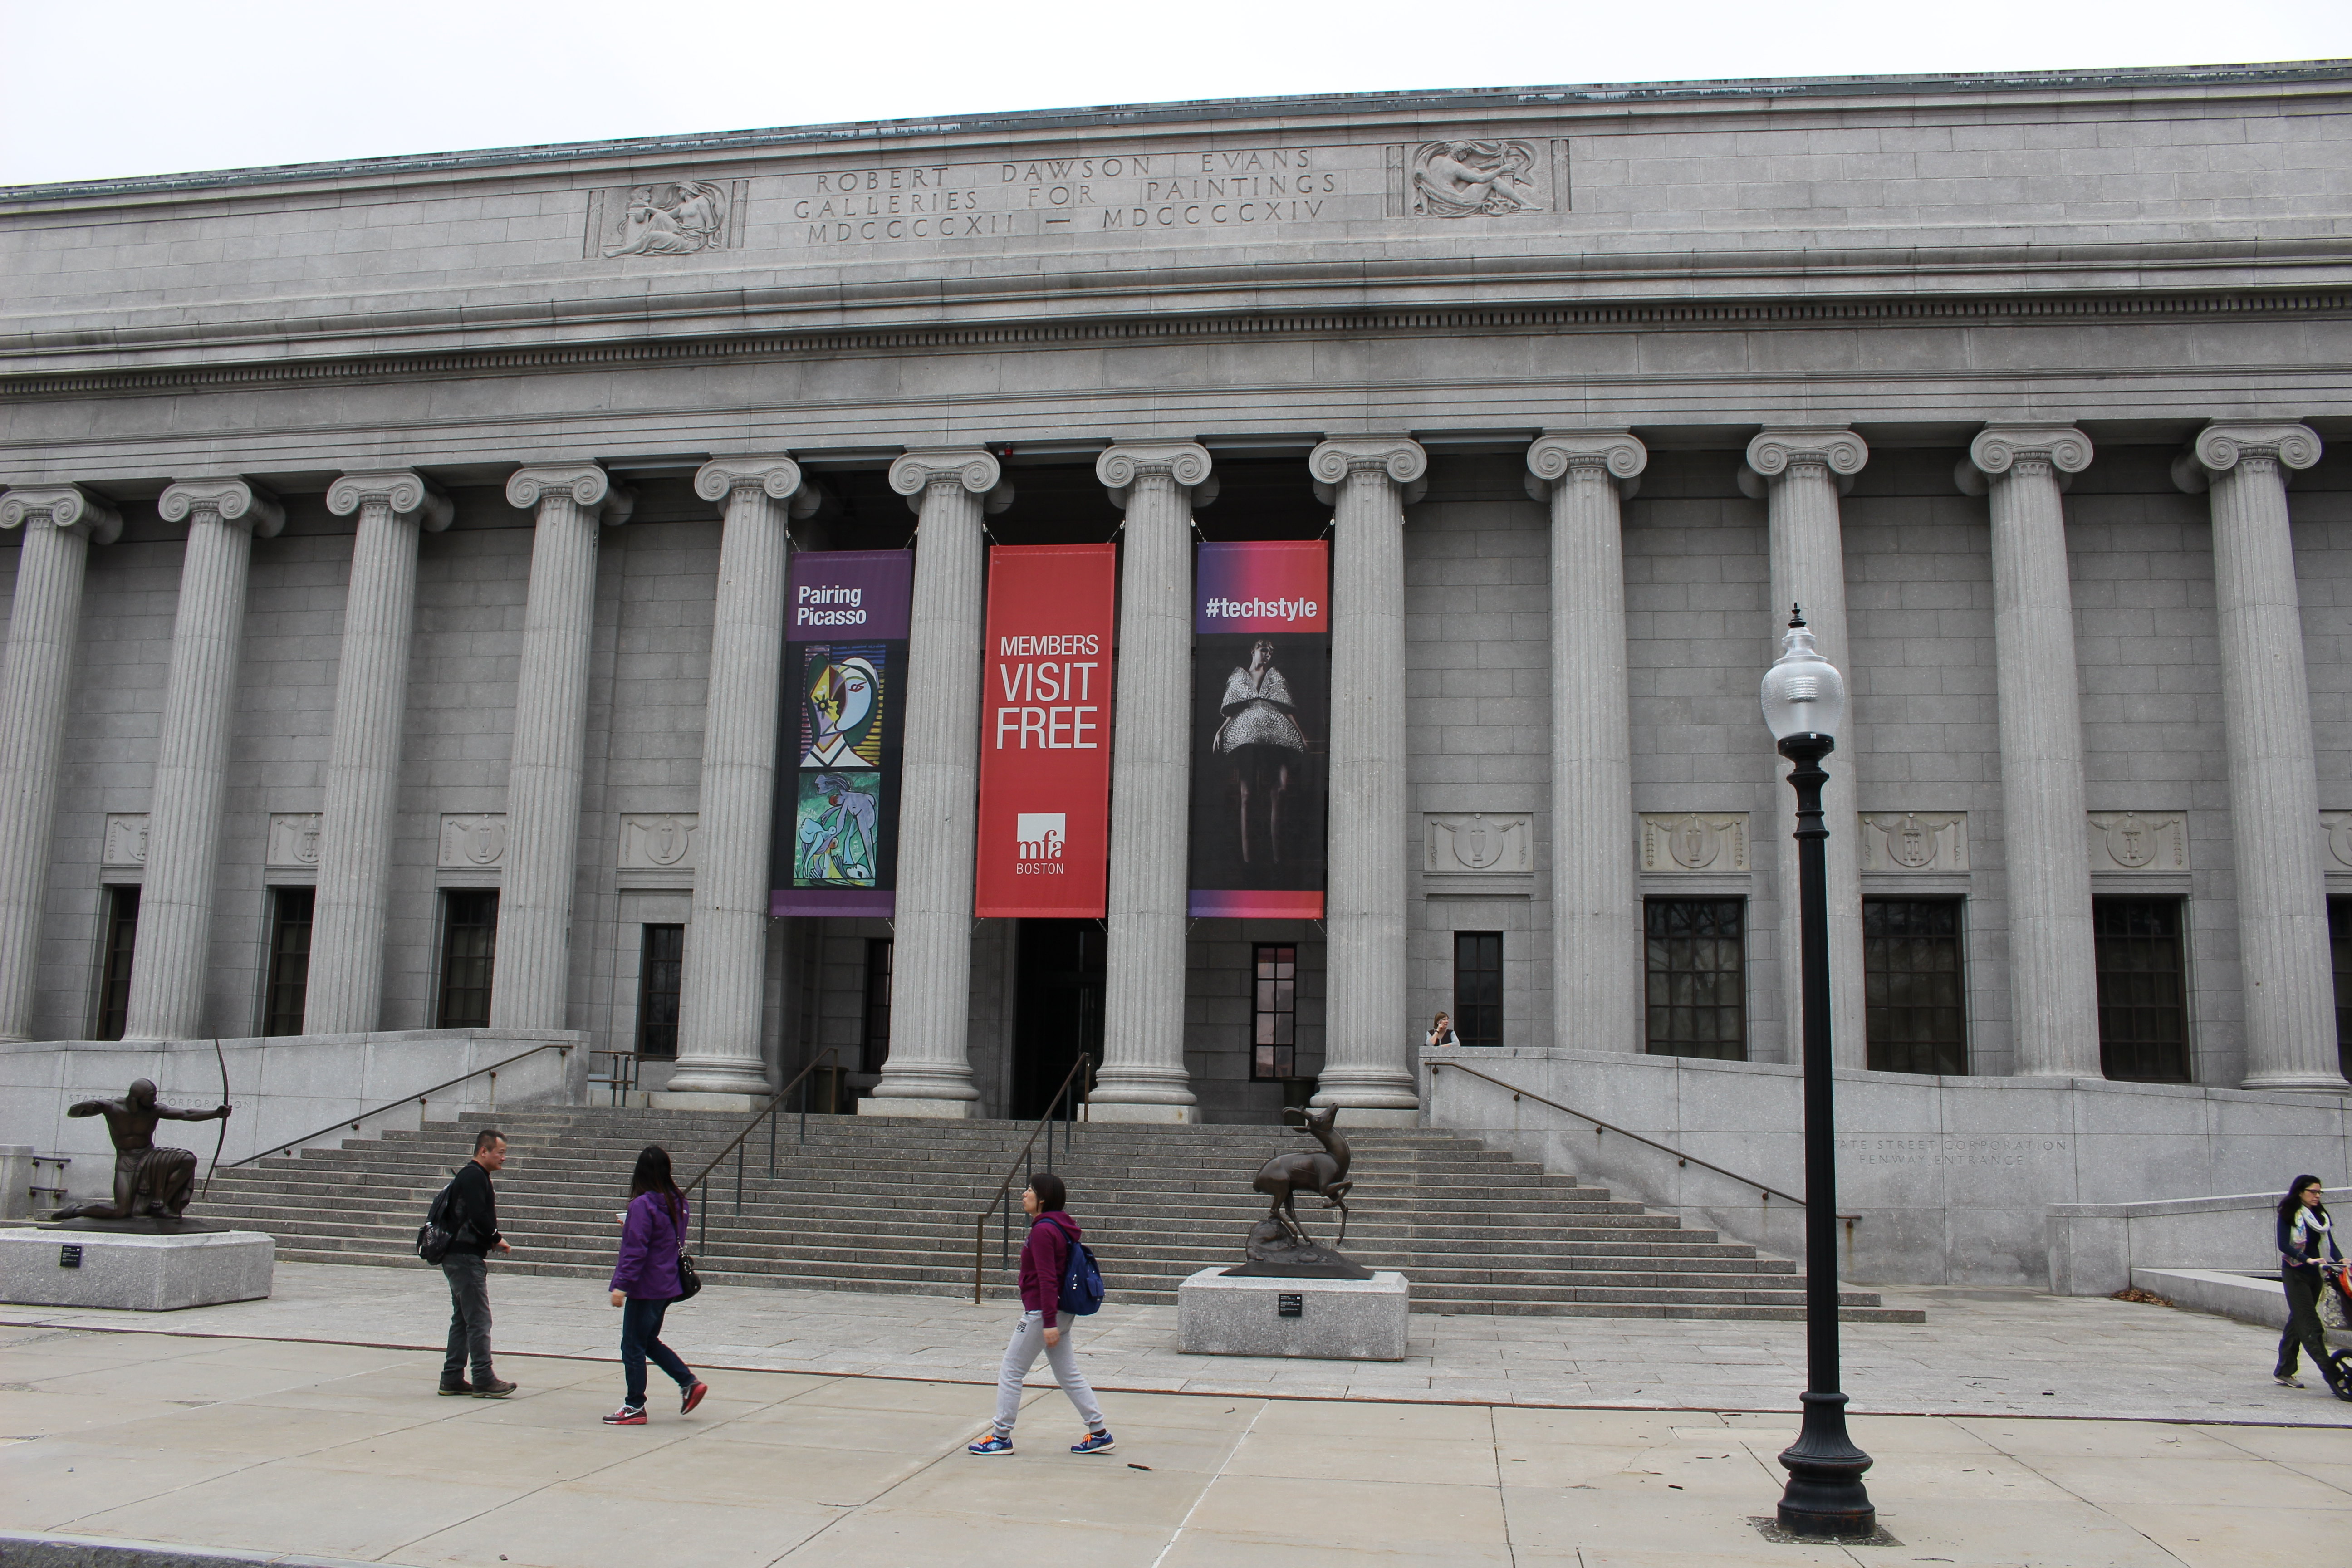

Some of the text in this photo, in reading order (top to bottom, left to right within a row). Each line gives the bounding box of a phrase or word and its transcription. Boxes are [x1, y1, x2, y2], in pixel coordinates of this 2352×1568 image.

[817, 150, 1309, 193] ROBERT DAWSON EVANS
[794, 174, 1335, 218] GALLERIES FOR PAINTINGS
[808, 215, 1012, 243] MDCCCCXII
[1103, 200, 1323, 228] MDCCCCXIV
[799, 585, 862, 607] Pairing
[797, 607, 867, 626] Picasso
[1205, 597, 1317, 621] #techstyle
[1000, 634, 1099, 656] MEMBERS
[1000, 662, 1098, 701] VISIT
[997, 706, 1098, 749] FREE
[1017, 829, 1065, 859] mfa
[1016, 863, 1063, 874] BOSTON
[1877, 1140, 1935, 1150] STREET
[1944, 1141, 2065, 1150] CORPORATION
[1860, 1155, 2023, 1165] FENWAY ENTRANCE
